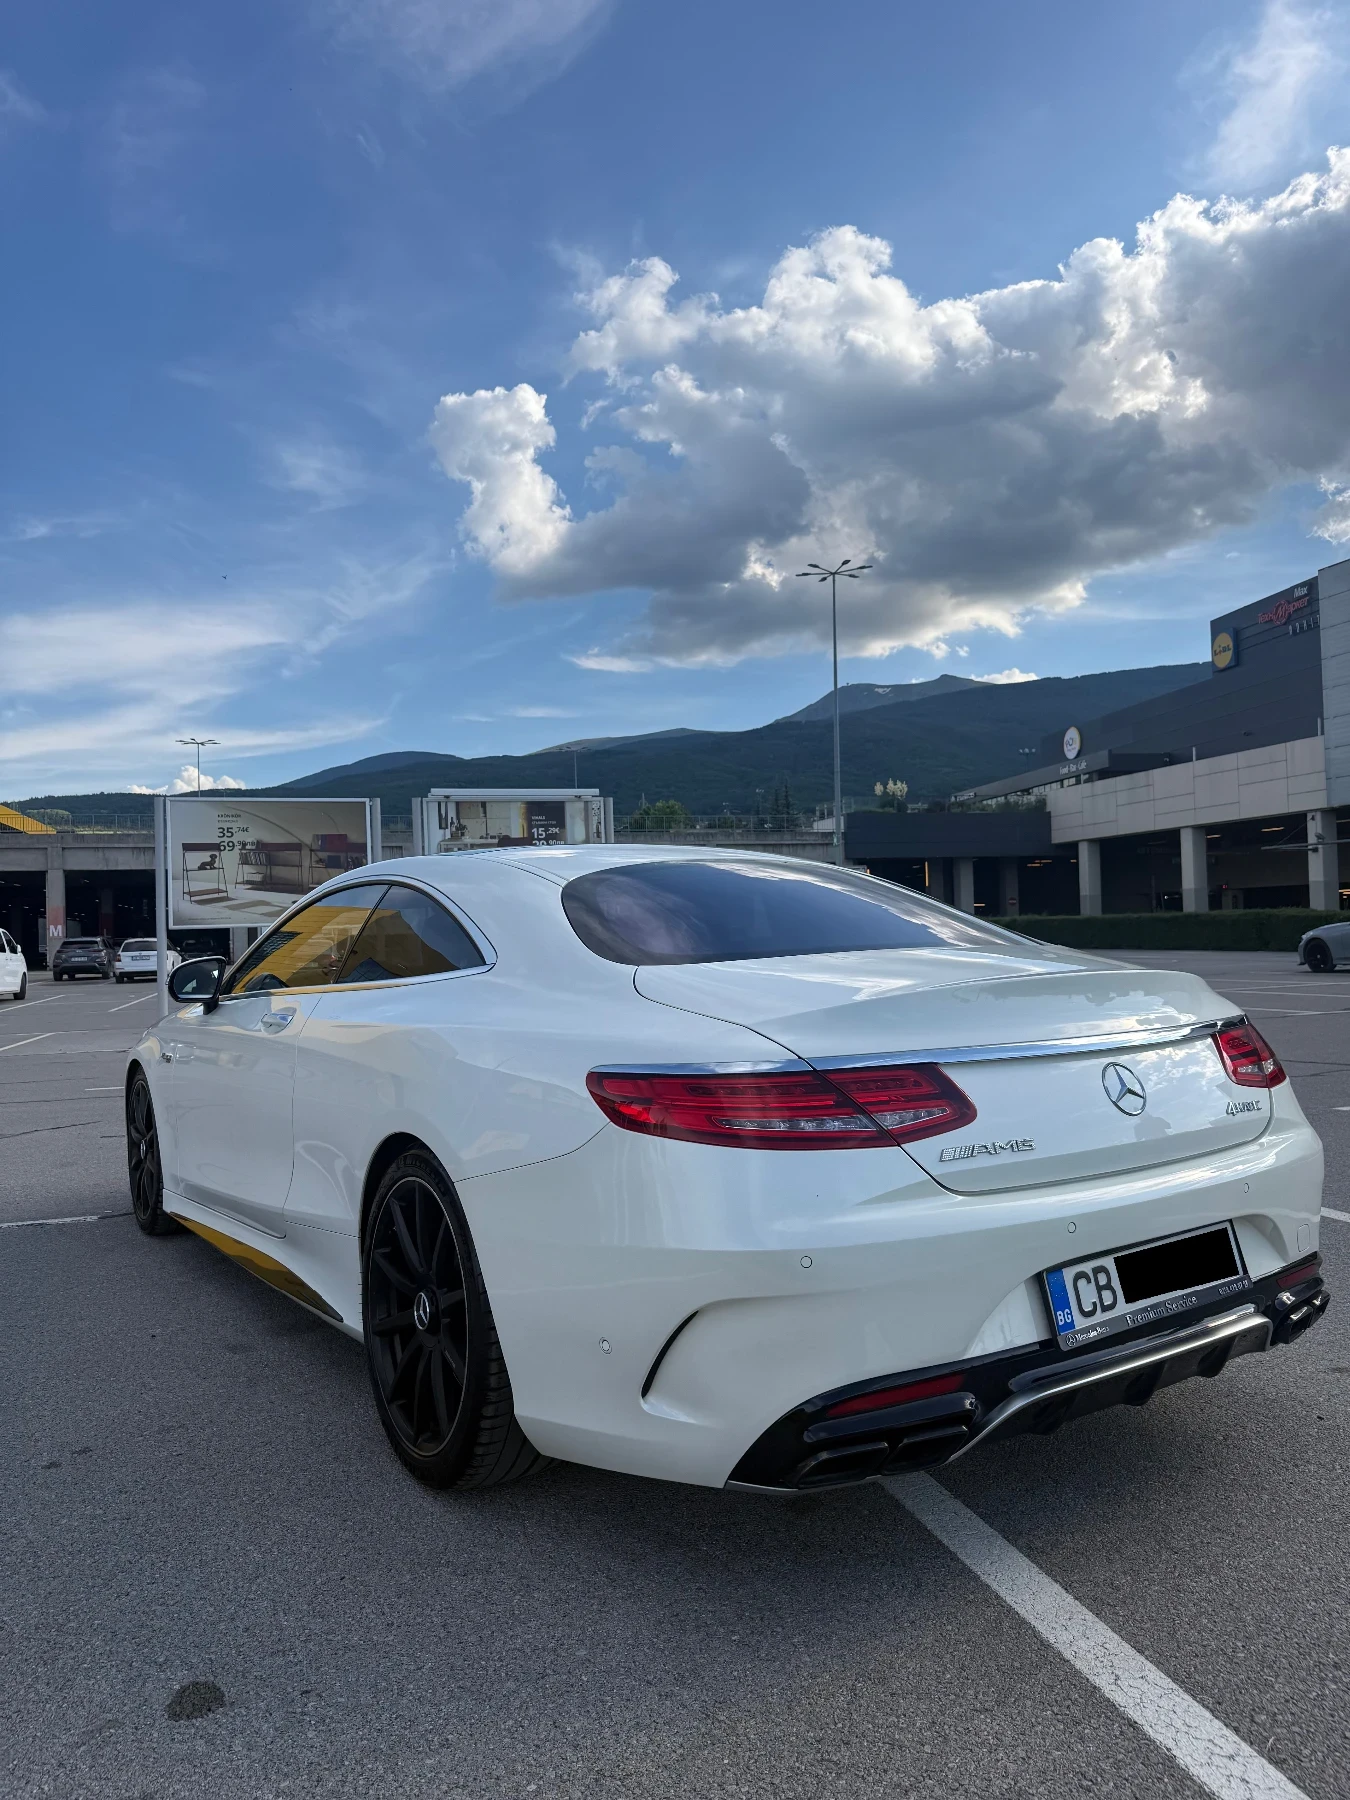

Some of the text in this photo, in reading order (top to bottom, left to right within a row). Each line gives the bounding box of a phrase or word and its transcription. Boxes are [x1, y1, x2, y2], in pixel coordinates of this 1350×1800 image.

[1294, 586, 1308, 598] Max
[49, 924, 62, 937] M
[969, 1137, 1035, 1158] AMG
[1057, 1308, 1072, 1326] BG
[1125, 1306, 1166, 1327] Premium
[1165, 1294, 1198, 1315] Service
